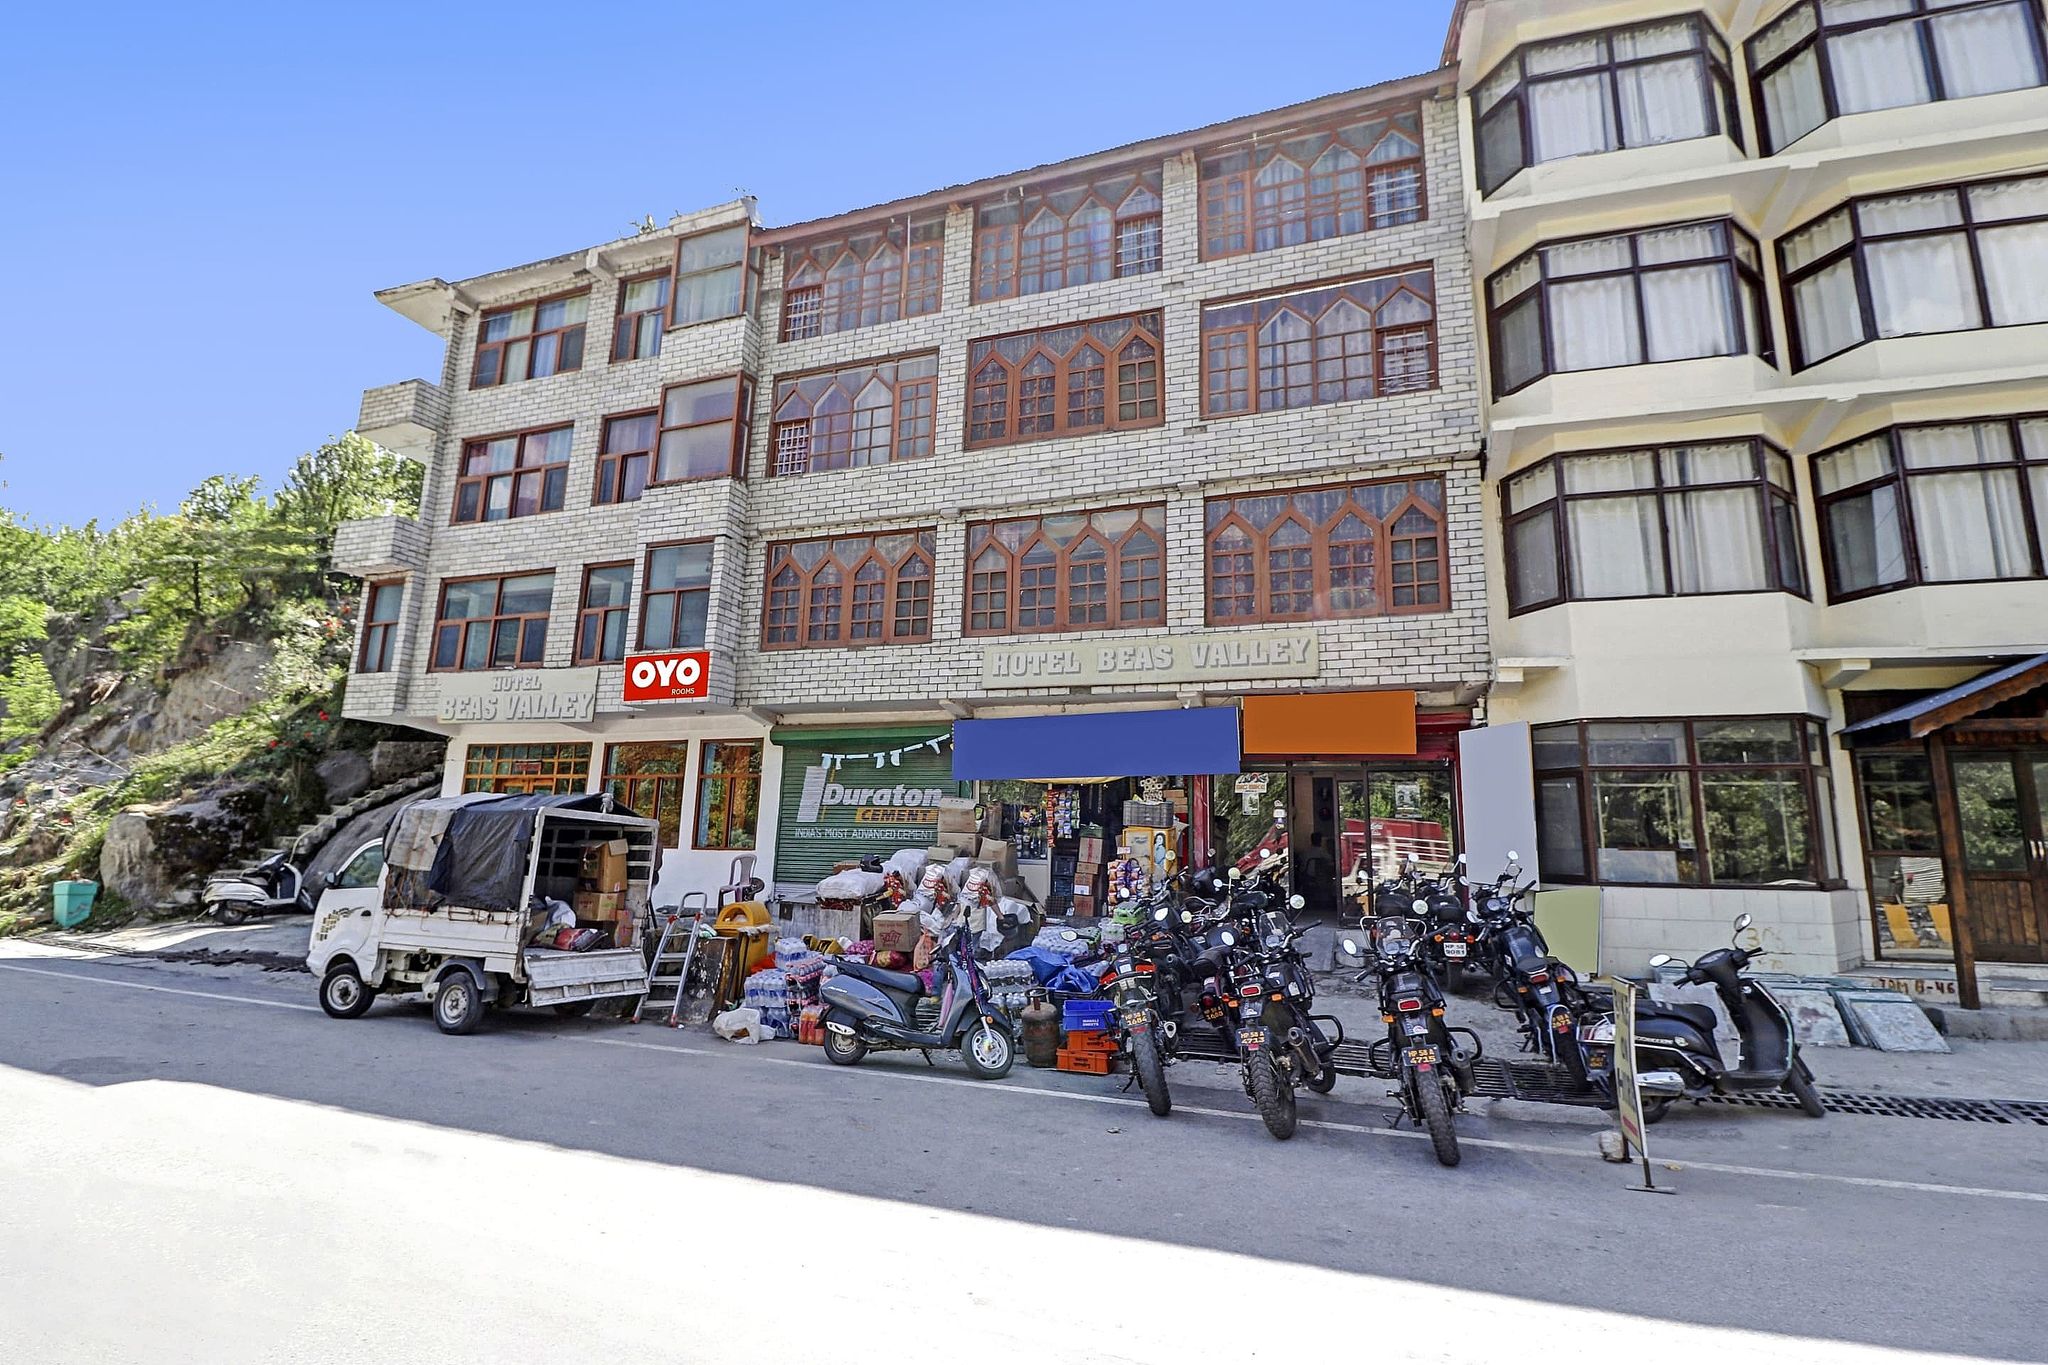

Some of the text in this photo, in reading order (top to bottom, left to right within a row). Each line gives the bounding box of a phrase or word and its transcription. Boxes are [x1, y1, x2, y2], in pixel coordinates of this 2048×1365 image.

[991, 637, 1312, 677] HOTEL BEAS VALLEY
[631, 657, 701, 688] OYO
[492, 675, 543, 692] HOTEL
[671, 687, 695, 696] ROOMS
[440, 692, 594, 720] BEAS VALLEY
[822, 783, 942, 807] Duraton
[861, 808, 932, 822] CEMENT
[824, 828, 849, 839] MOST
[851, 828, 896, 839] ADVANCED
[896, 829, 935, 841] CEMENT
